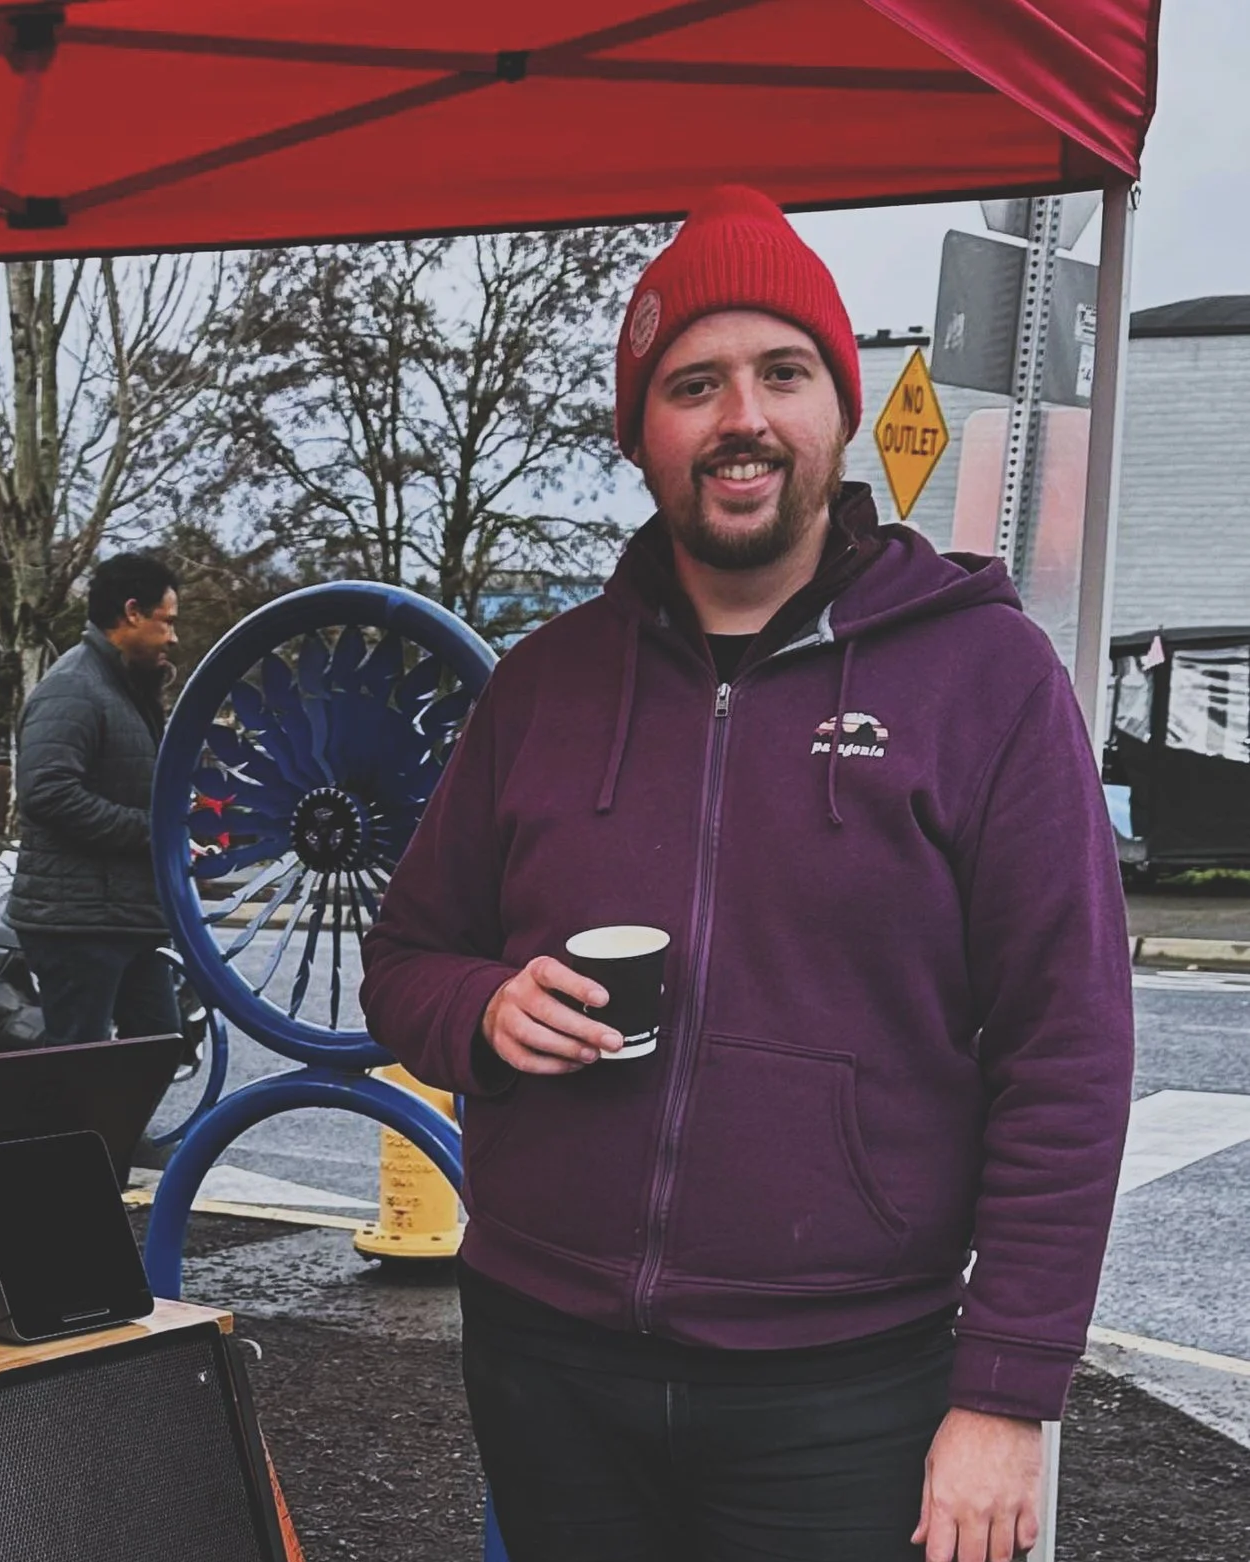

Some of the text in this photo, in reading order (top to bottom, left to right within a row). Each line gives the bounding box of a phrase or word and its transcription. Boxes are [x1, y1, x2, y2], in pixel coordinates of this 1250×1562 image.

[902, 384, 924, 414] NO
[883, 422, 939, 456] OUTLET
[810, 741, 885, 758] paagonia
